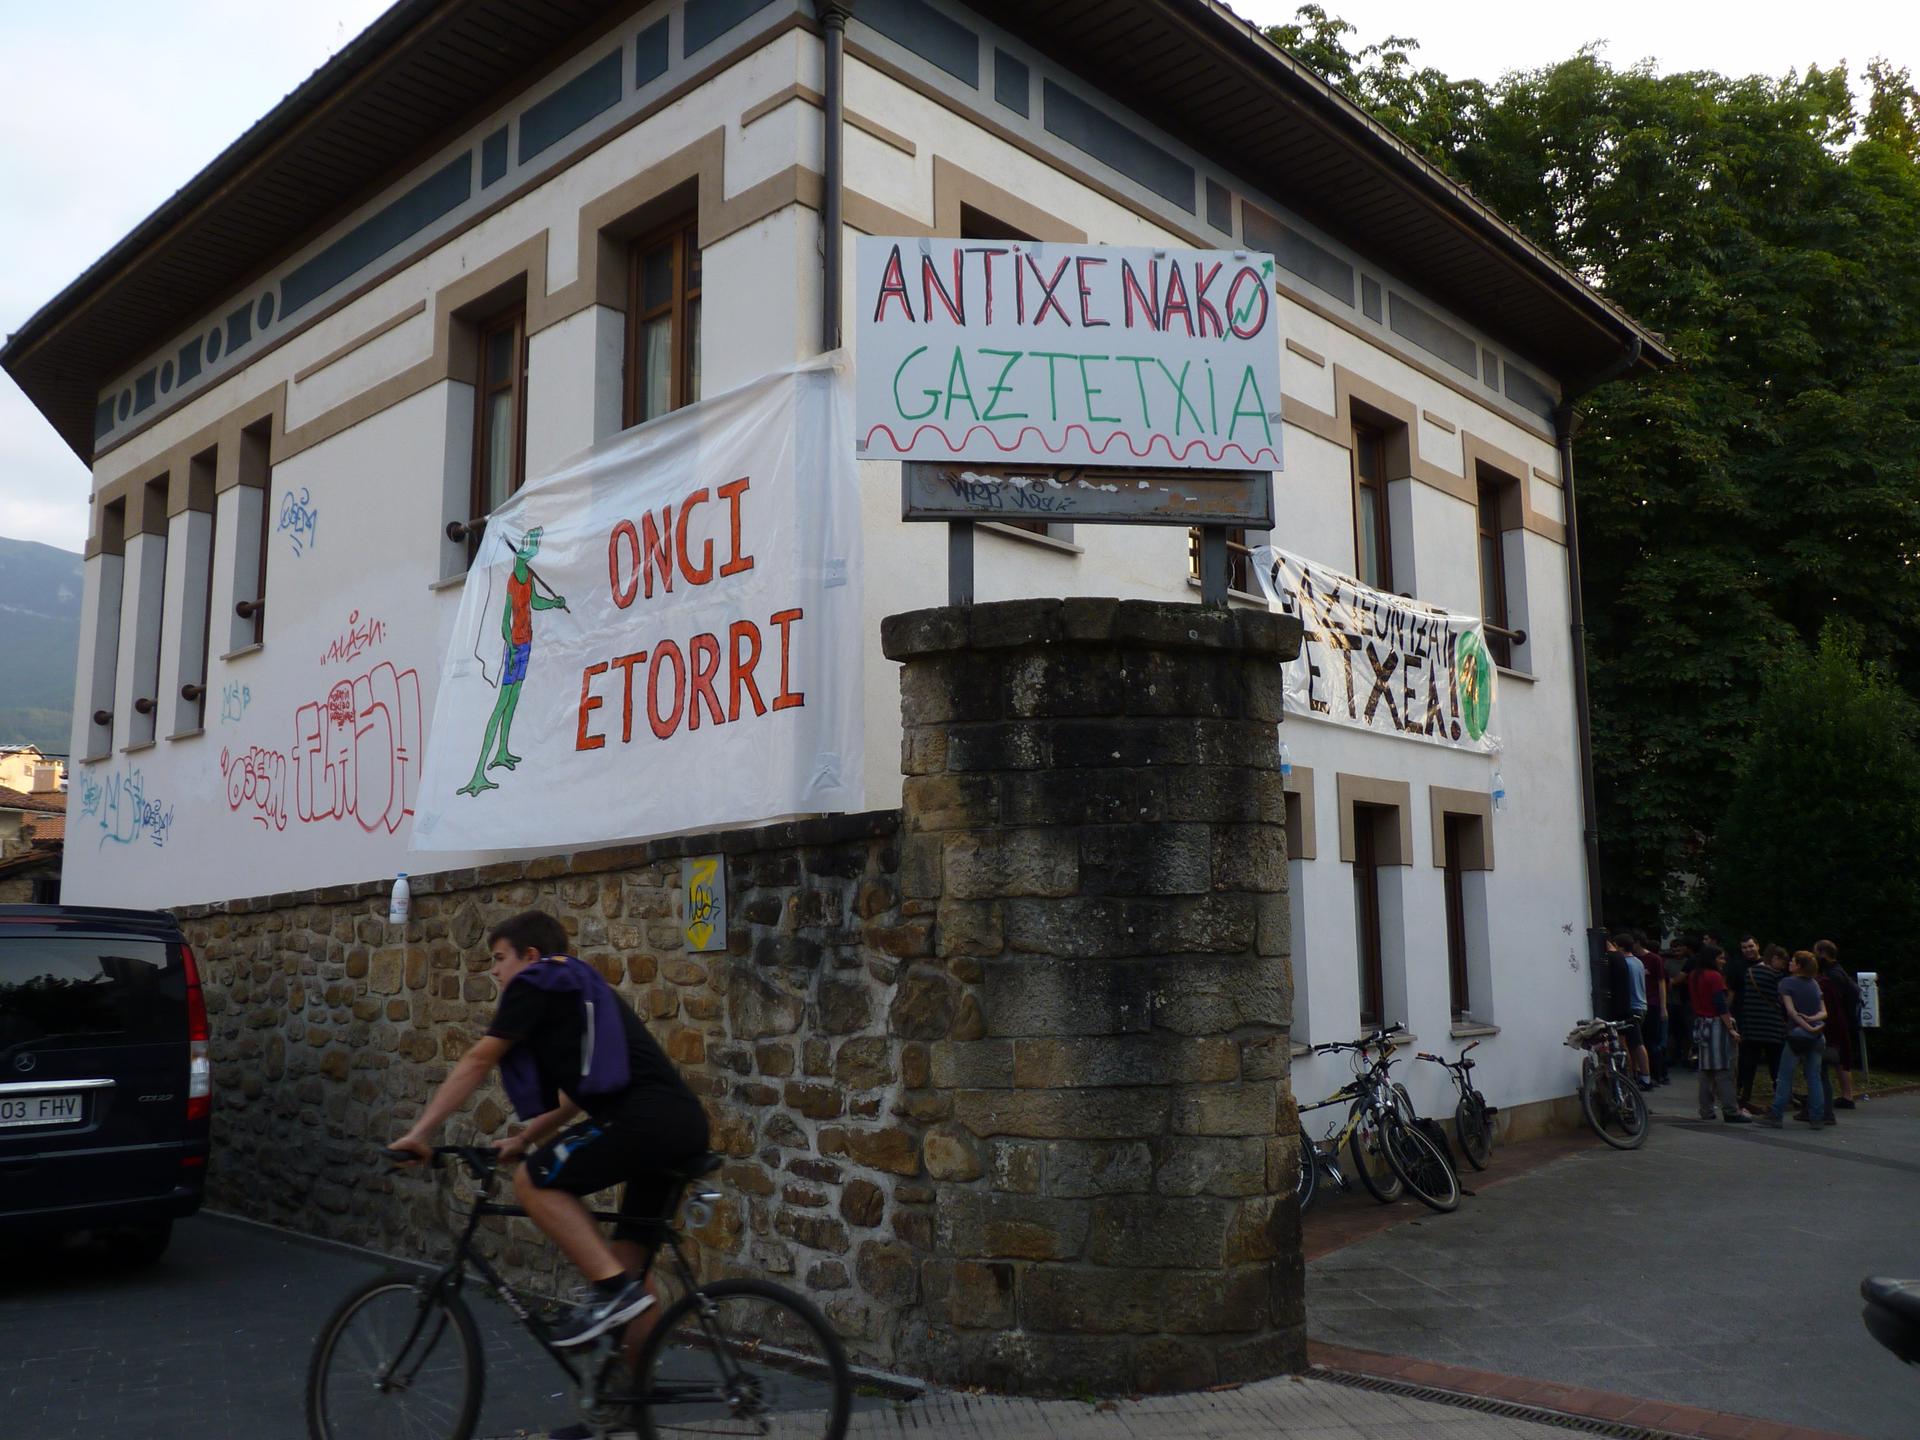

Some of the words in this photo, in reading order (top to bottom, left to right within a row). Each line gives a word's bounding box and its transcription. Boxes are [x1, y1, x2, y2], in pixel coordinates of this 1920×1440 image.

[873, 243, 1270, 340] ANTIXENAKO
[892, 344, 1273, 446] GAZTETXIA
[607, 476, 755, 610] ONGI
[575, 607, 806, 752] ETORRI
[39, 1098, 77, 1117] FHV
